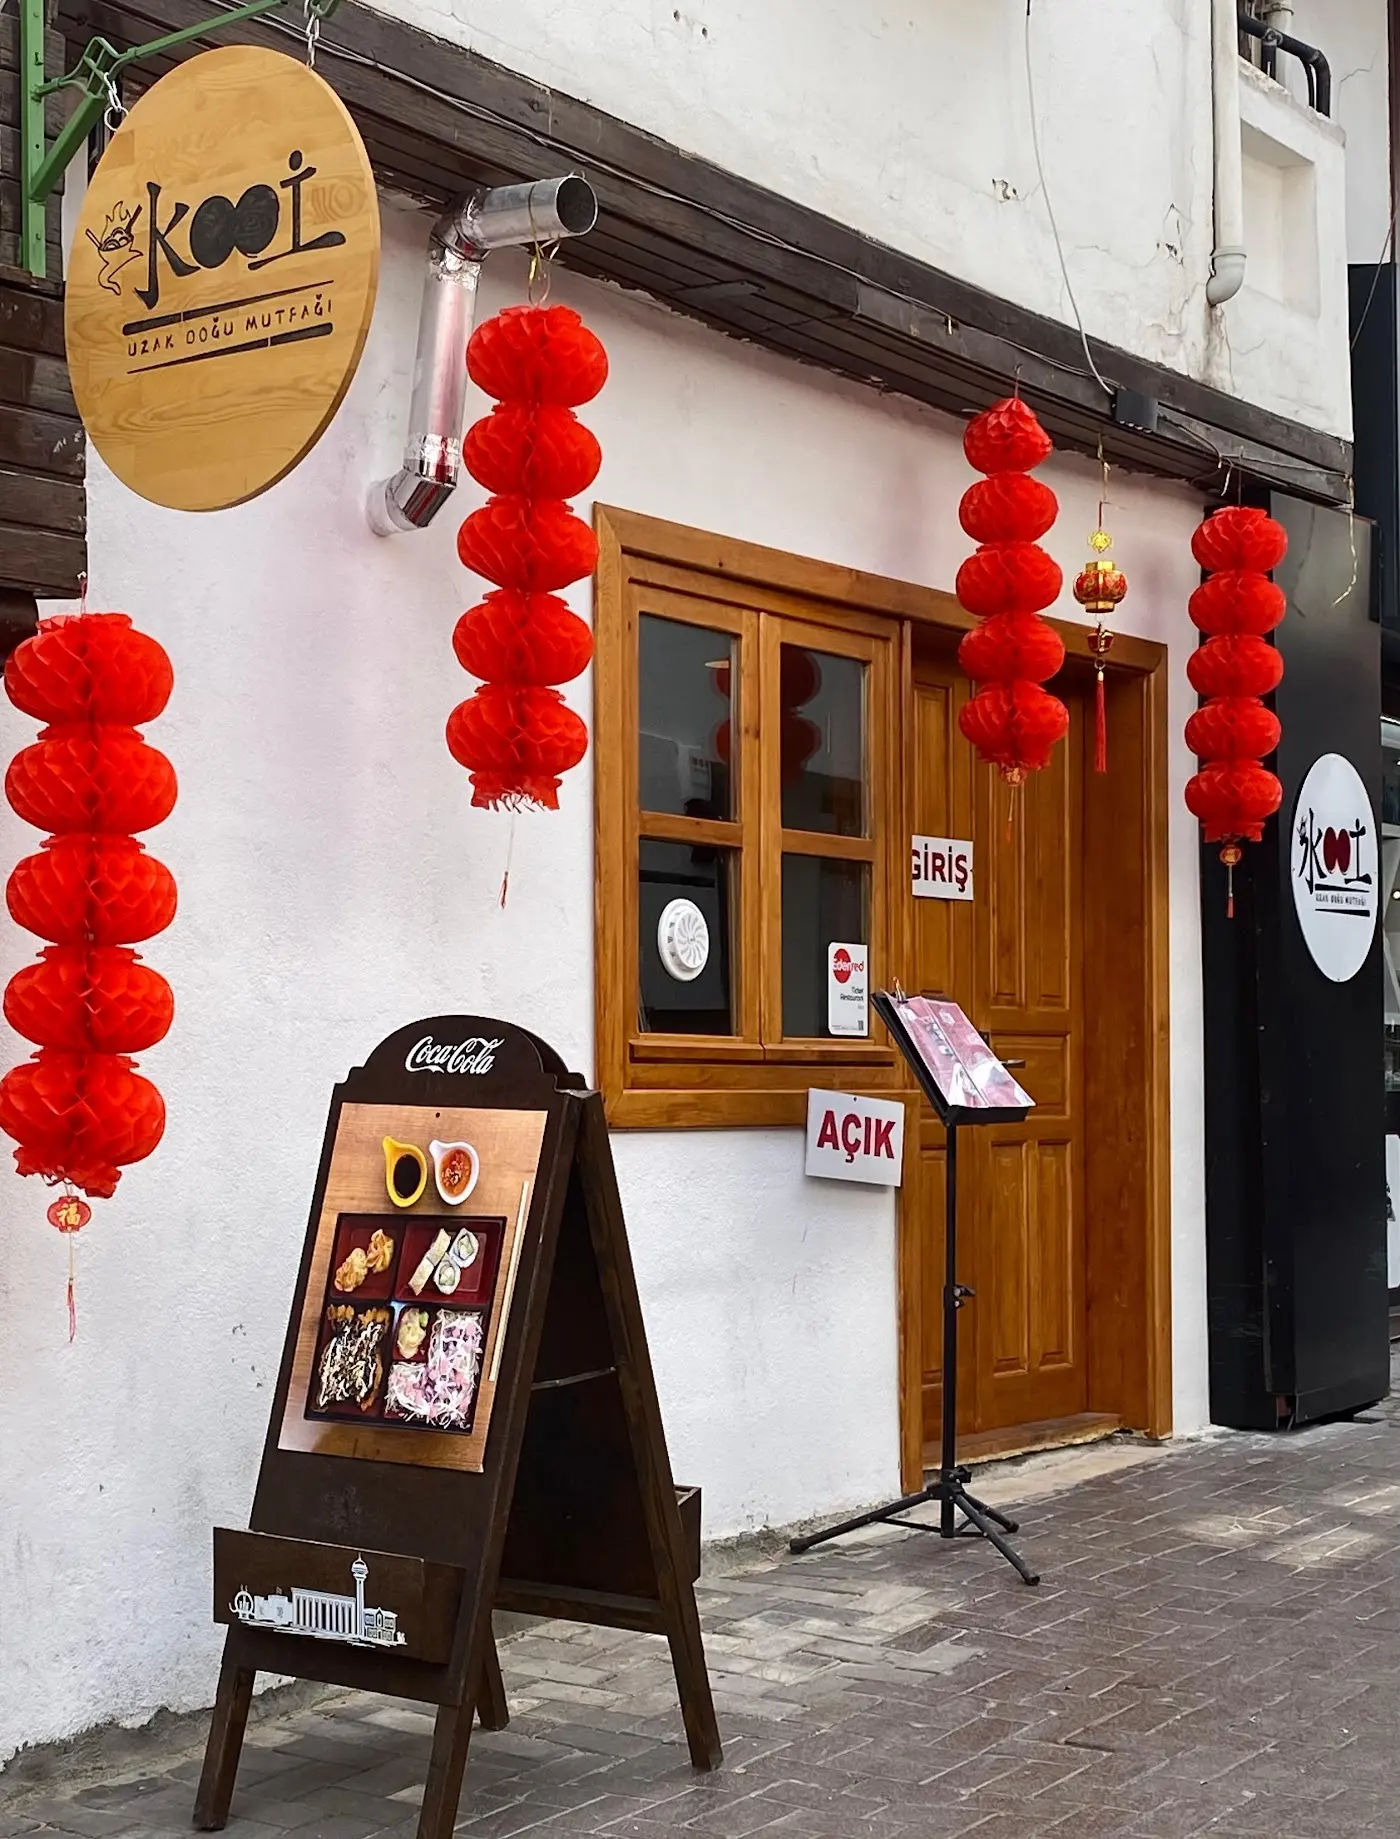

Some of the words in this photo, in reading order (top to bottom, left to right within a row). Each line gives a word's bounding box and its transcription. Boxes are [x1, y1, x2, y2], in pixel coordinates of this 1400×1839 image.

[127, 335, 175, 357] UZAK
[186, 317, 234, 345] DOĞU
[245, 294, 332, 331] MUTFAĞI
[911, 843, 968, 893] GİRİŞ
[816, 1110, 896, 1163] AÇIK
